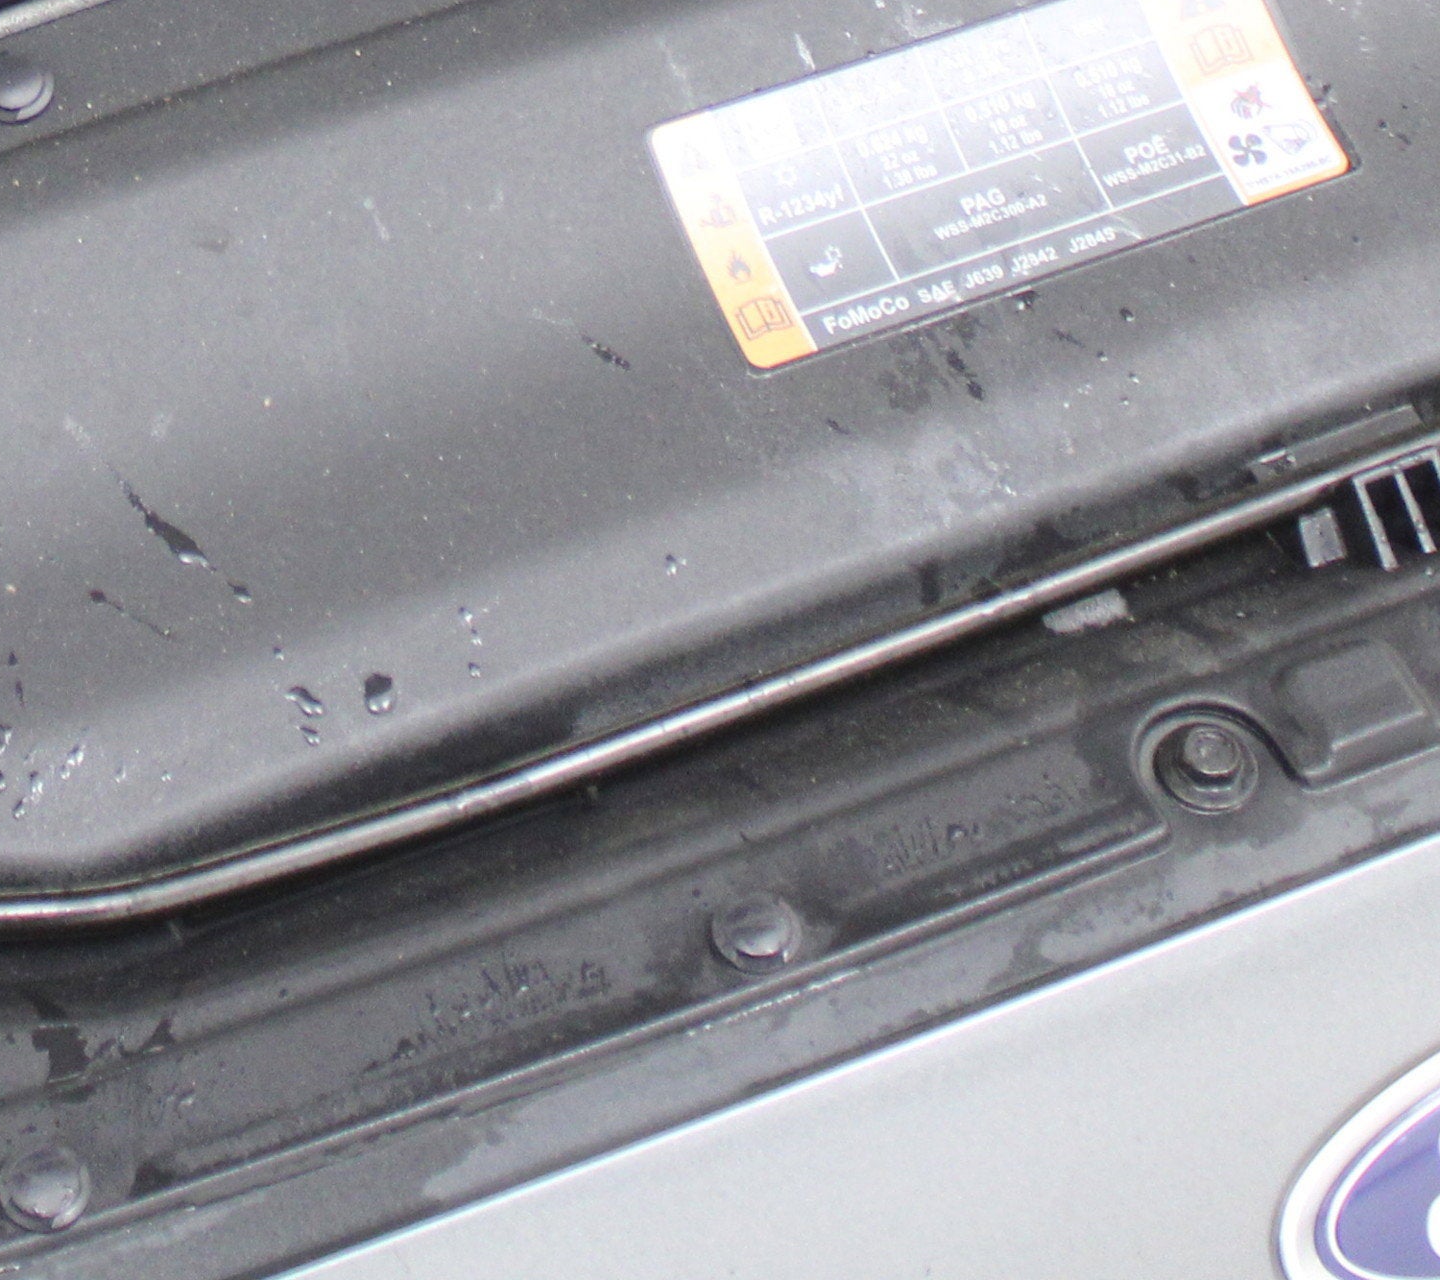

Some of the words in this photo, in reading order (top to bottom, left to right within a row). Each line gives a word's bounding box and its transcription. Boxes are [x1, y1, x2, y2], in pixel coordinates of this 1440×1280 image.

[1109, 51, 1144, 79] kg
[1003, 88, 1038, 116] kg
[1122, 90, 1151, 111] lbs
[895, 121, 931, 150] kg
[1014, 125, 1043, 147] lbs
[1122, 135, 1170, 166] POE
[912, 160, 938, 181] lbs
[757, 183, 848, 229] R-1234yf
[959, 186, 1007, 217] PAG
[933, 191, 1049, 242] WSS-M2C300-A2
[822, 291, 912, 336] FoMoCo
[915, 278, 957, 304] SAE
[960, 261, 1004, 289] J639
